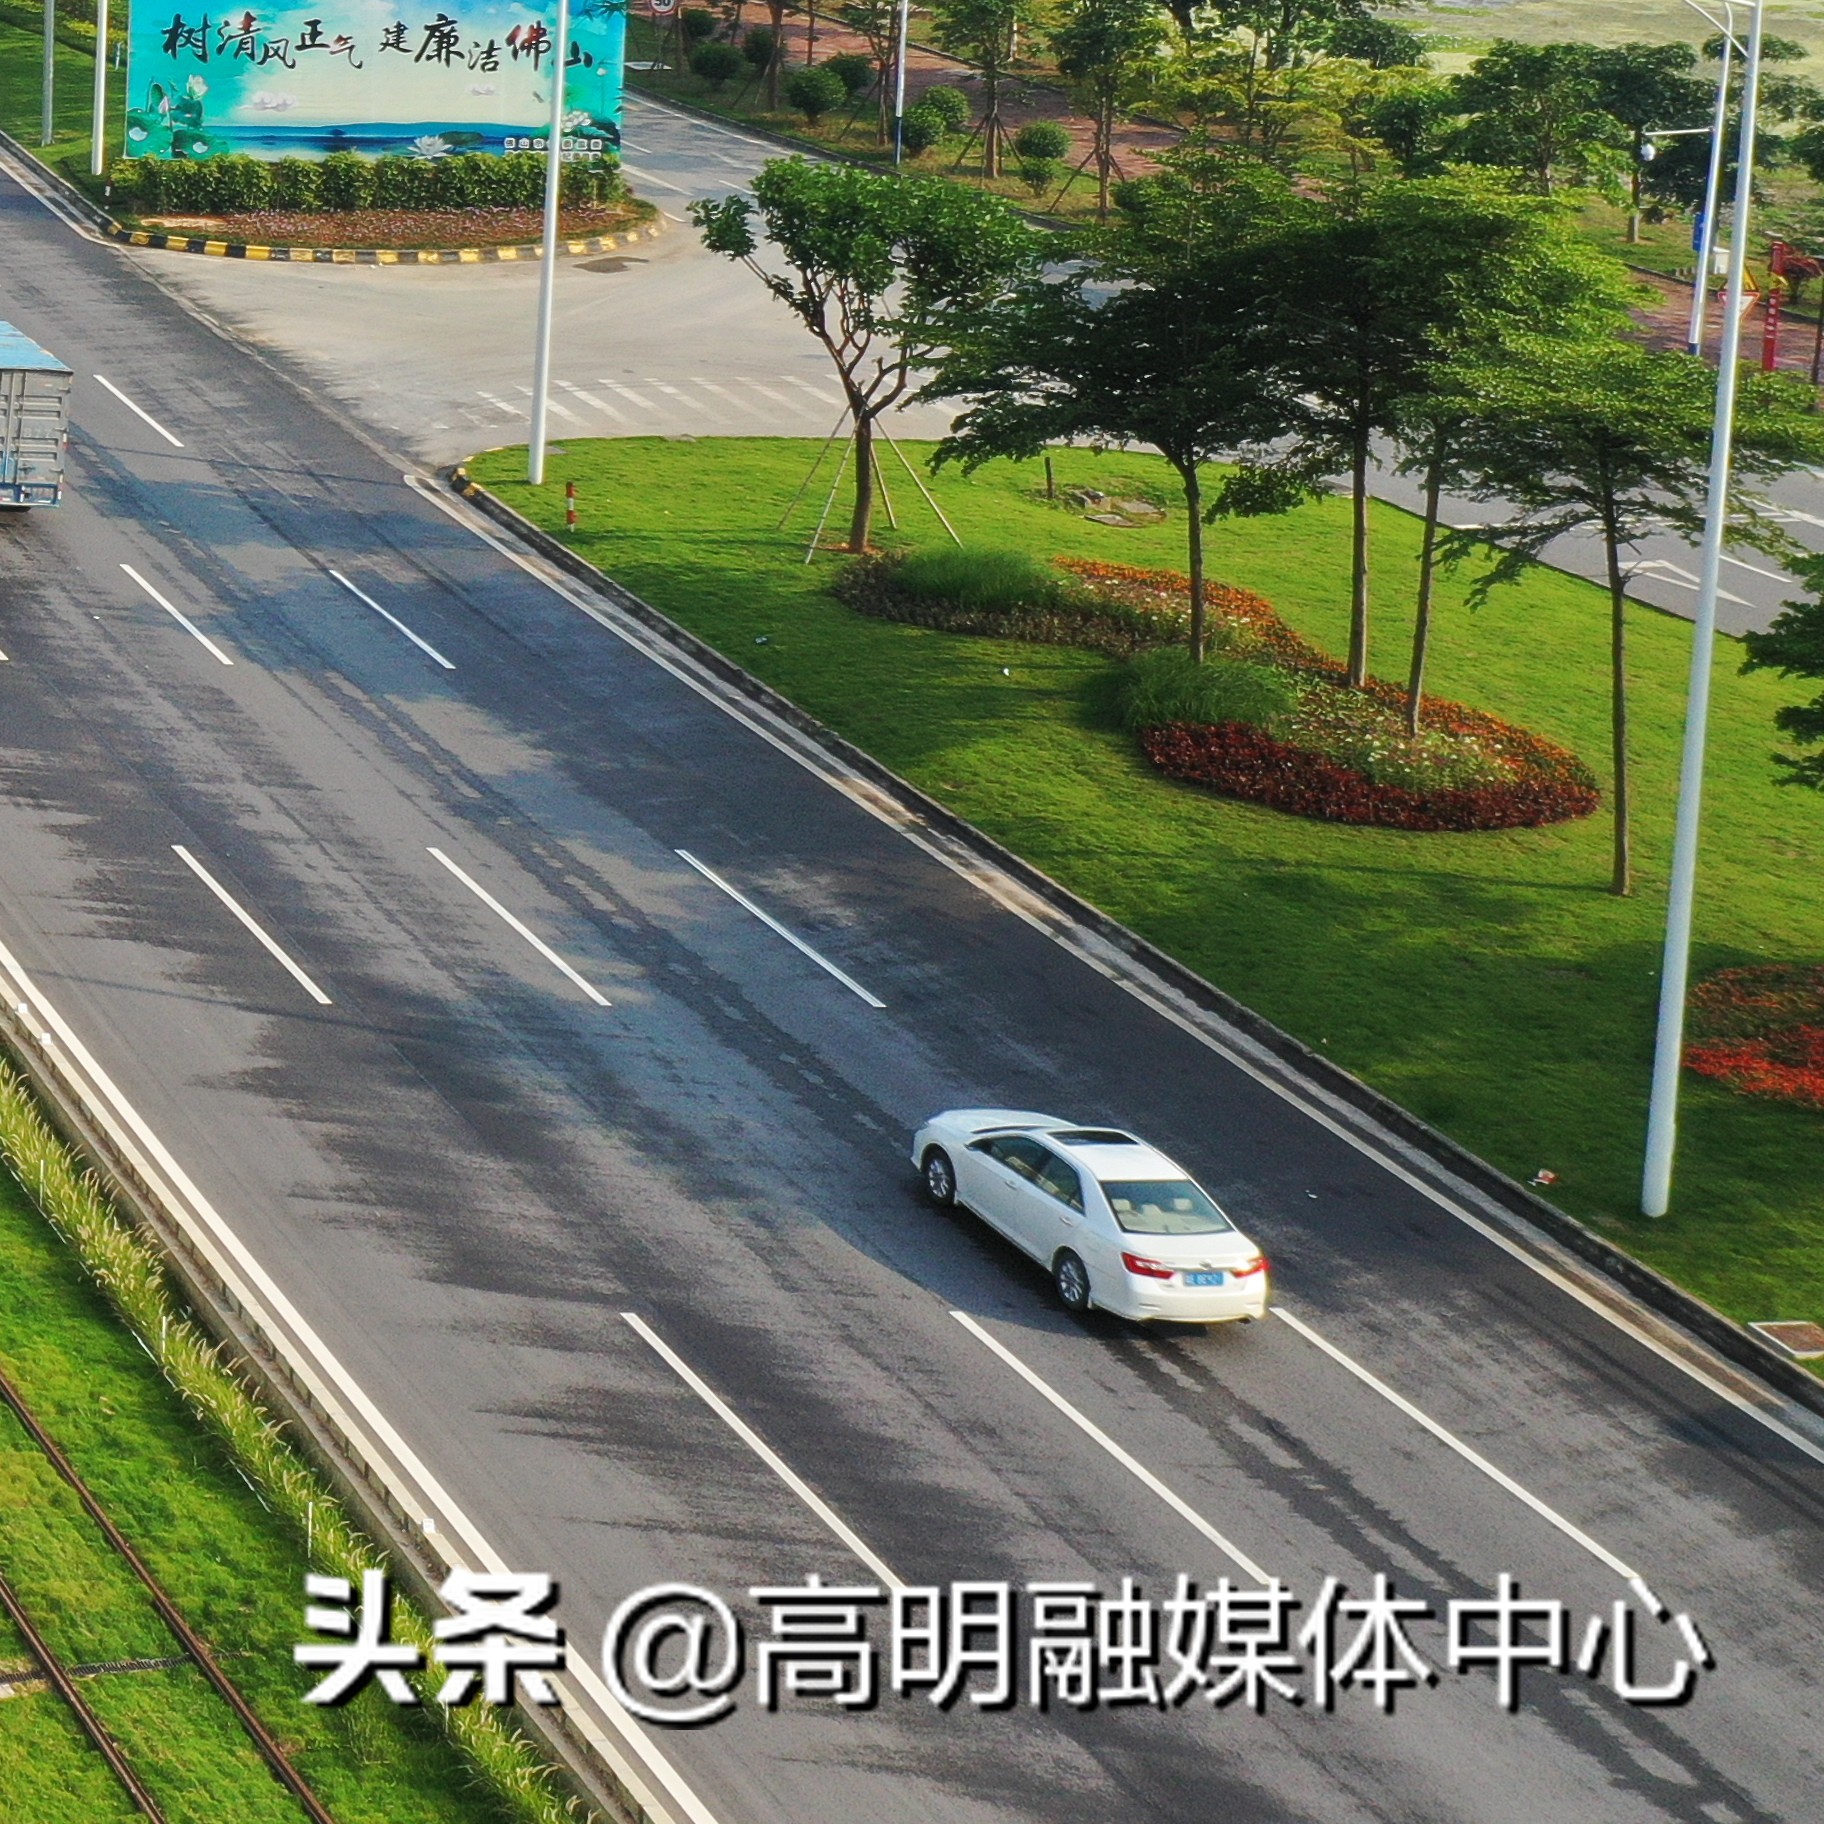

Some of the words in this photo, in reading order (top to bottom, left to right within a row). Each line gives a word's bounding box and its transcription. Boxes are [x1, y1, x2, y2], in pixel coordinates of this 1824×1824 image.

[161, 10, 364, 70] 树清风正气
[378, 12, 594, 73] 建廉洁佛山
